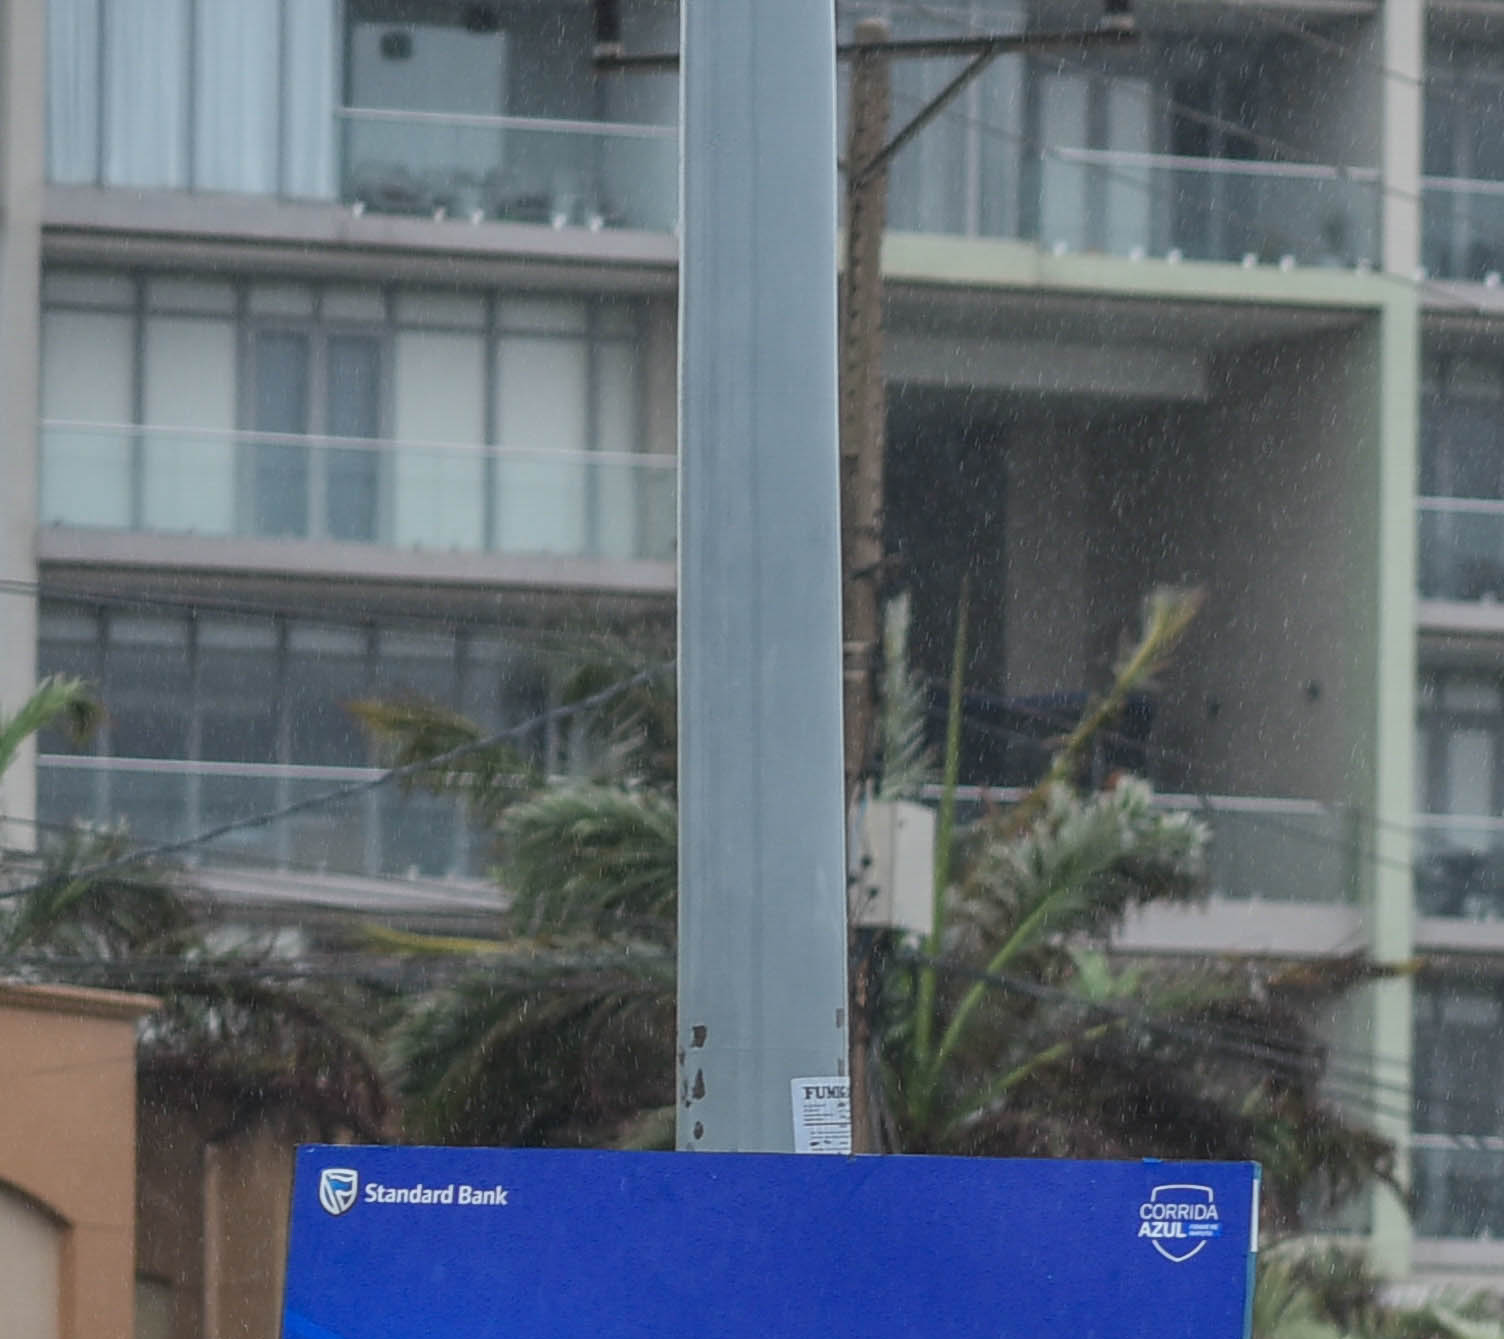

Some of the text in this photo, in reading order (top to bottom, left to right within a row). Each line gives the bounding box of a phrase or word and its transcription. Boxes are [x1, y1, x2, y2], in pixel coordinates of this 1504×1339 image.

[364, 1183, 509, 1206] Standard Bank
[1139, 1203, 1219, 1221] CORRIDA
[1137, 1221, 1187, 1238] AZUL
